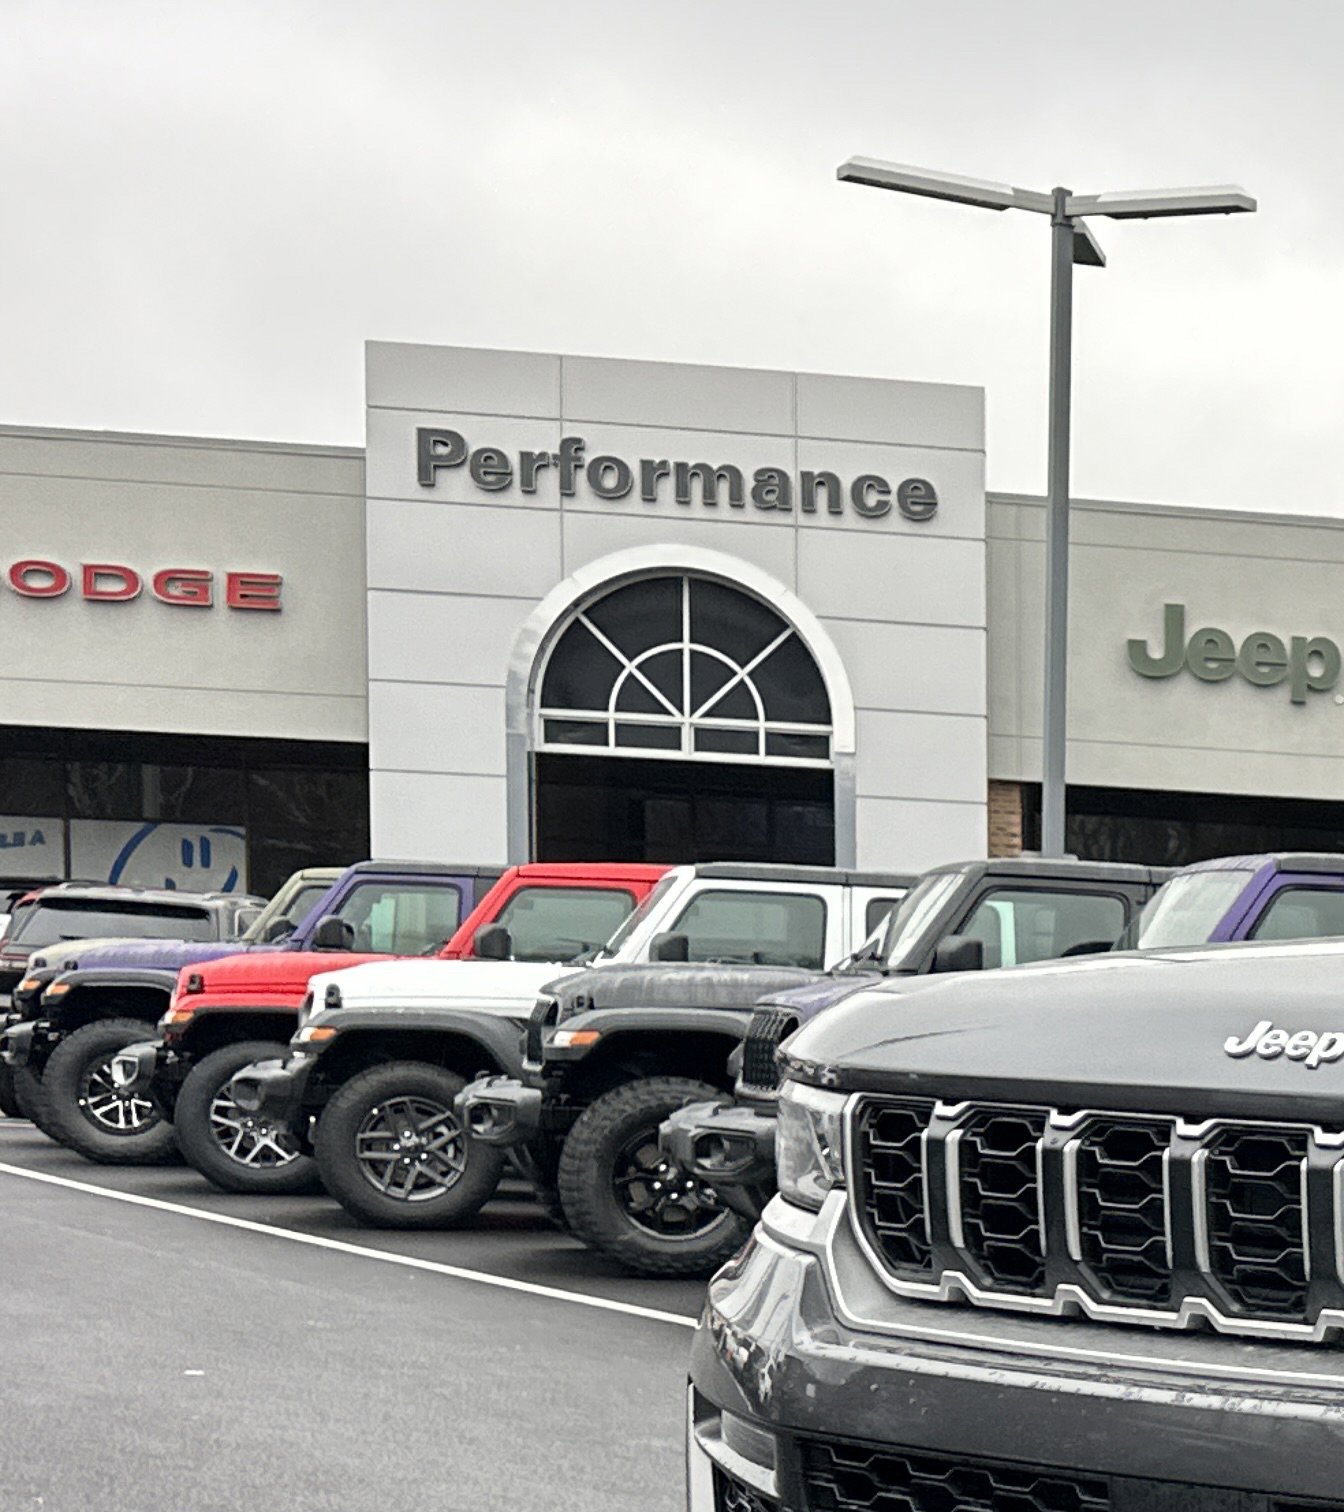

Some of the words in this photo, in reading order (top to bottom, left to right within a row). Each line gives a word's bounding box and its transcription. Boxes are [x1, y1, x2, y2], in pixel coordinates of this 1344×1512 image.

[415, 427, 938, 521] Performance
[0, 560, 283, 613] ODGE
[1127, 603, 1341, 704] Jeep
